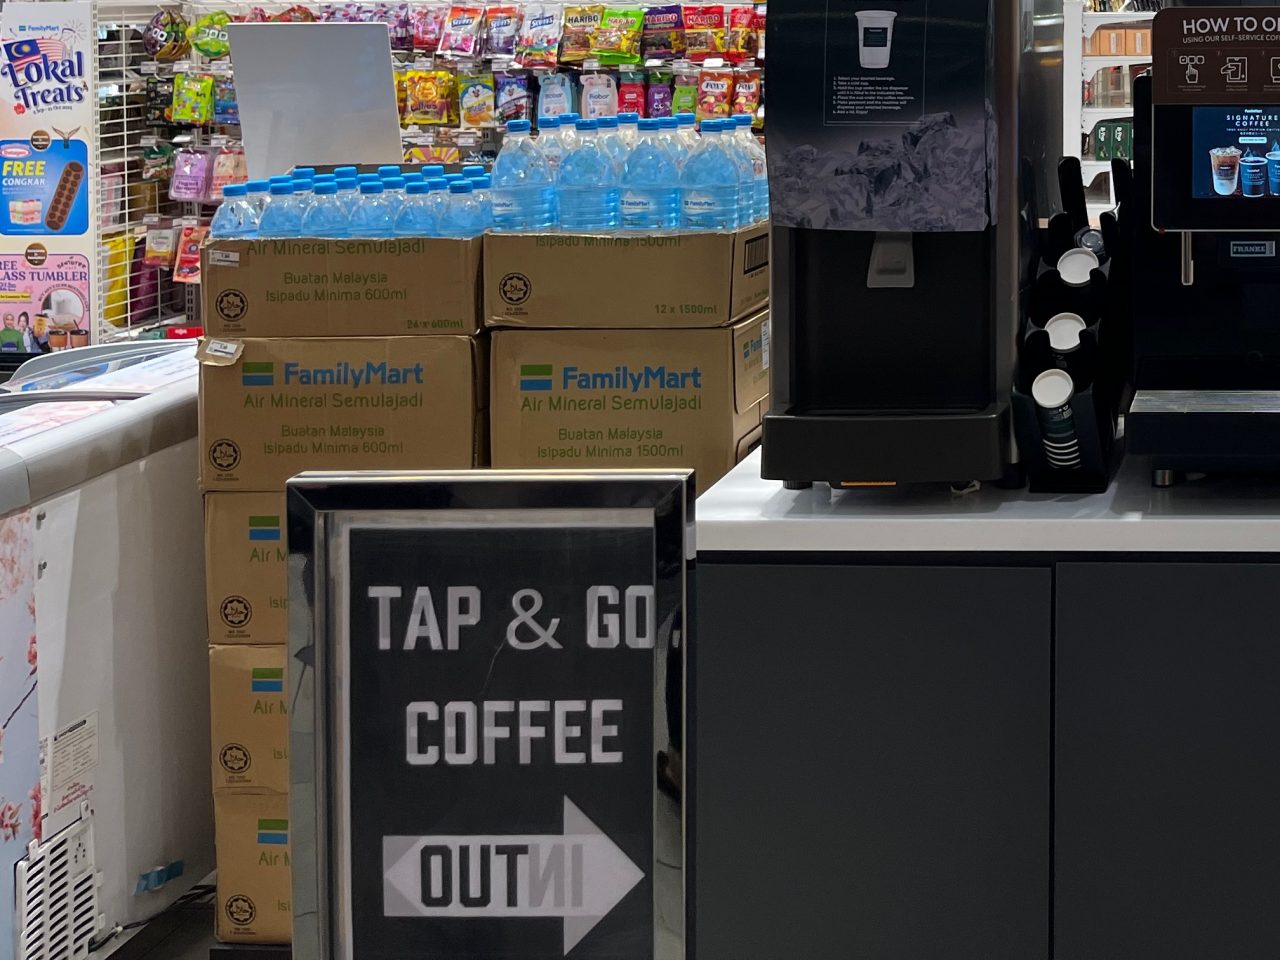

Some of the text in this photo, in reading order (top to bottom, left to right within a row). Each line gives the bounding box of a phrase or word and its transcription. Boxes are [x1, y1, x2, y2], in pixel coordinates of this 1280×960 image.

[568, 15, 598, 24] HARIBO
[644, 14, 678, 24] HARIBO
[688, 15, 720, 24] HARIBO
[1182, 18, 1230, 35] HOW
[1234, 17, 1257, 32] TO
[1183, 36, 1203, 44] USING
[1, 51, 83, 87] Lokal
[14, 84, 83, 108] Treats
[2, 161, 46, 176] FREE
[247, 240, 425, 257] Air Mineral Semulajadi
[29, 272, 88, 281] TUMBLER
[284, 272, 388, 286] Buatan Malaysia
[266, 289, 407, 304] Isipadu Minima 600ml
[655, 305, 667, 314] 12
[679, 304, 718, 314] 1500ml
[284, 362, 423, 388] FamilyMart
[563, 366, 701, 392] FamilyMart
[244, 392, 423, 410] Air Mineral Semulajadi
[521, 395, 702, 413] Air Mineral Semulajadi
[281, 425, 384, 438] Buatan Malaysia
[558, 428, 663, 442] Buatan Malaysia
[264, 441, 403, 455] Isipadu Minima 600ml
[538, 444, 683, 459] Isipadu Minima 1500ml
[250, 548, 271, 563] Air
[368, 585, 655, 650] TAP & GO
[253, 700, 273, 714] Air
[405, 699, 623, 765] COFFEE
[259, 851, 280, 866] Air
[420, 844, 528, 908] OUT
